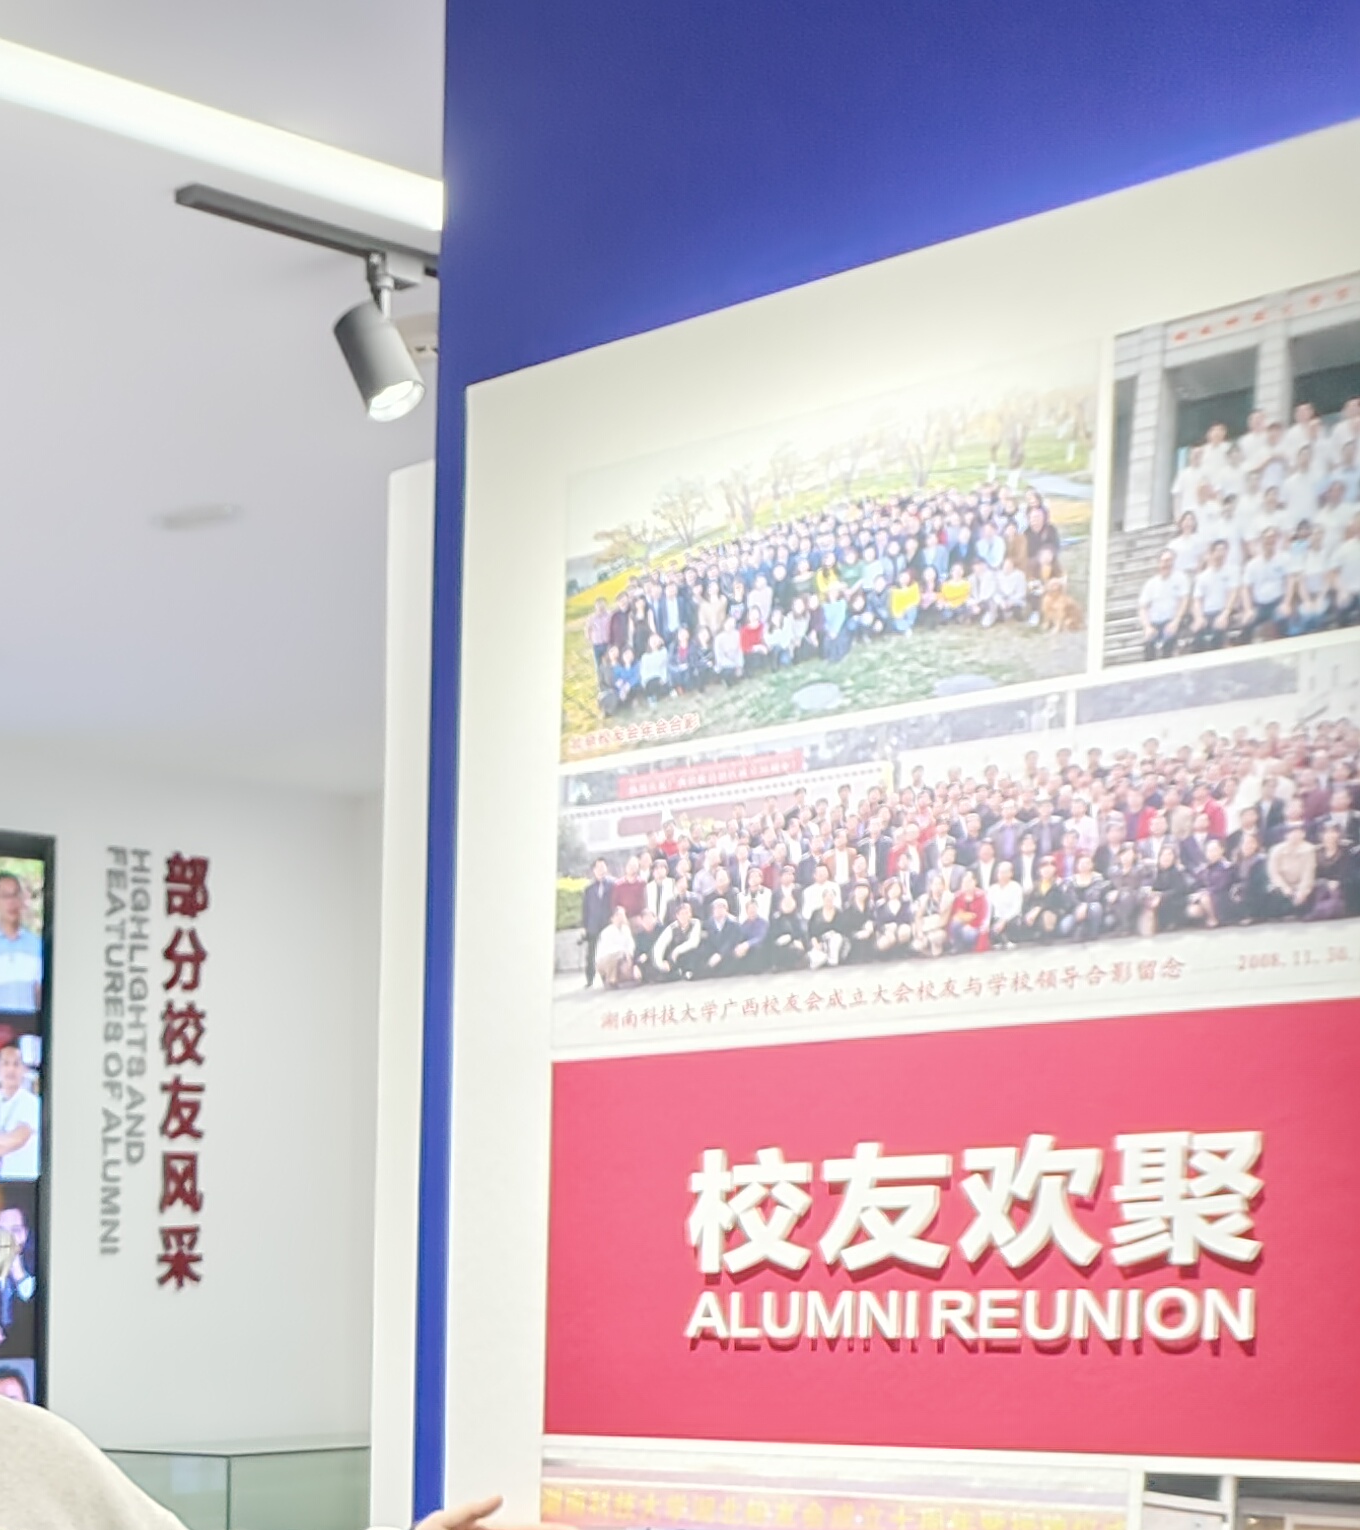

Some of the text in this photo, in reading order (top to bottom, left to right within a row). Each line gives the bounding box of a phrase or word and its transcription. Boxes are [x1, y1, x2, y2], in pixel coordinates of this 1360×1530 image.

[99, 845, 128, 1256] FEATURES OF ALUMNI
[125, 848, 152, 1165] HIGHLIGHTS AND
[156, 850, 210, 1291] 部分校友风采
[684, 1287, 1256, 1342] ALUMNI REUNION
[687, 1131, 1264, 1275] 校友欢聚
